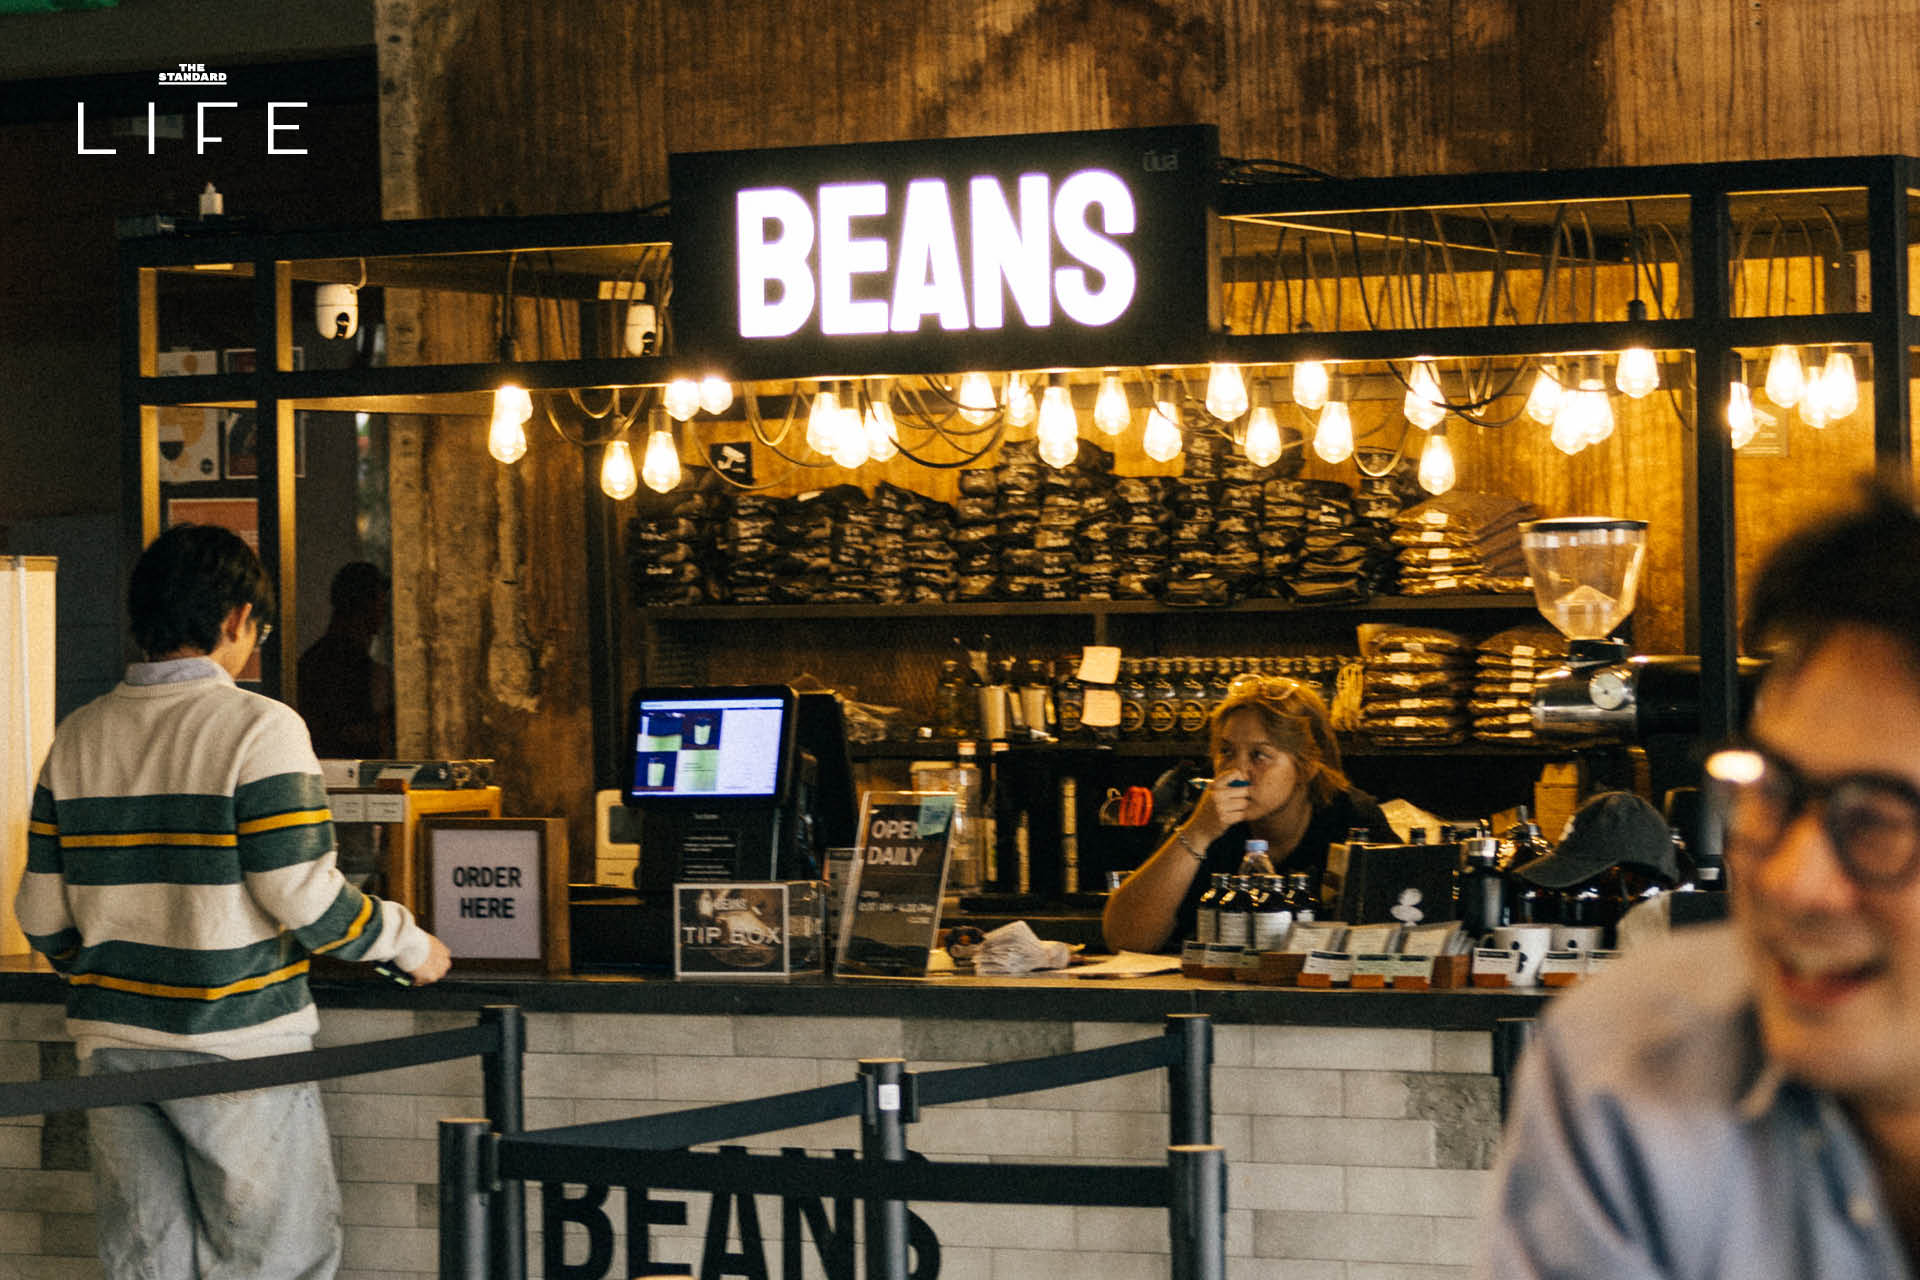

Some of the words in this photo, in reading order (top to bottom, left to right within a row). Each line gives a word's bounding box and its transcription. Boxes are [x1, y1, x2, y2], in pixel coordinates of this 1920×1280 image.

[736, 167, 1137, 339] BEANS
[866, 846, 924, 866] DAILY
[453, 866, 522, 888] ORDER
[460, 897, 515, 918] HERE
[681, 926, 722, 945] TIP
[728, 926, 783, 946] BOX
